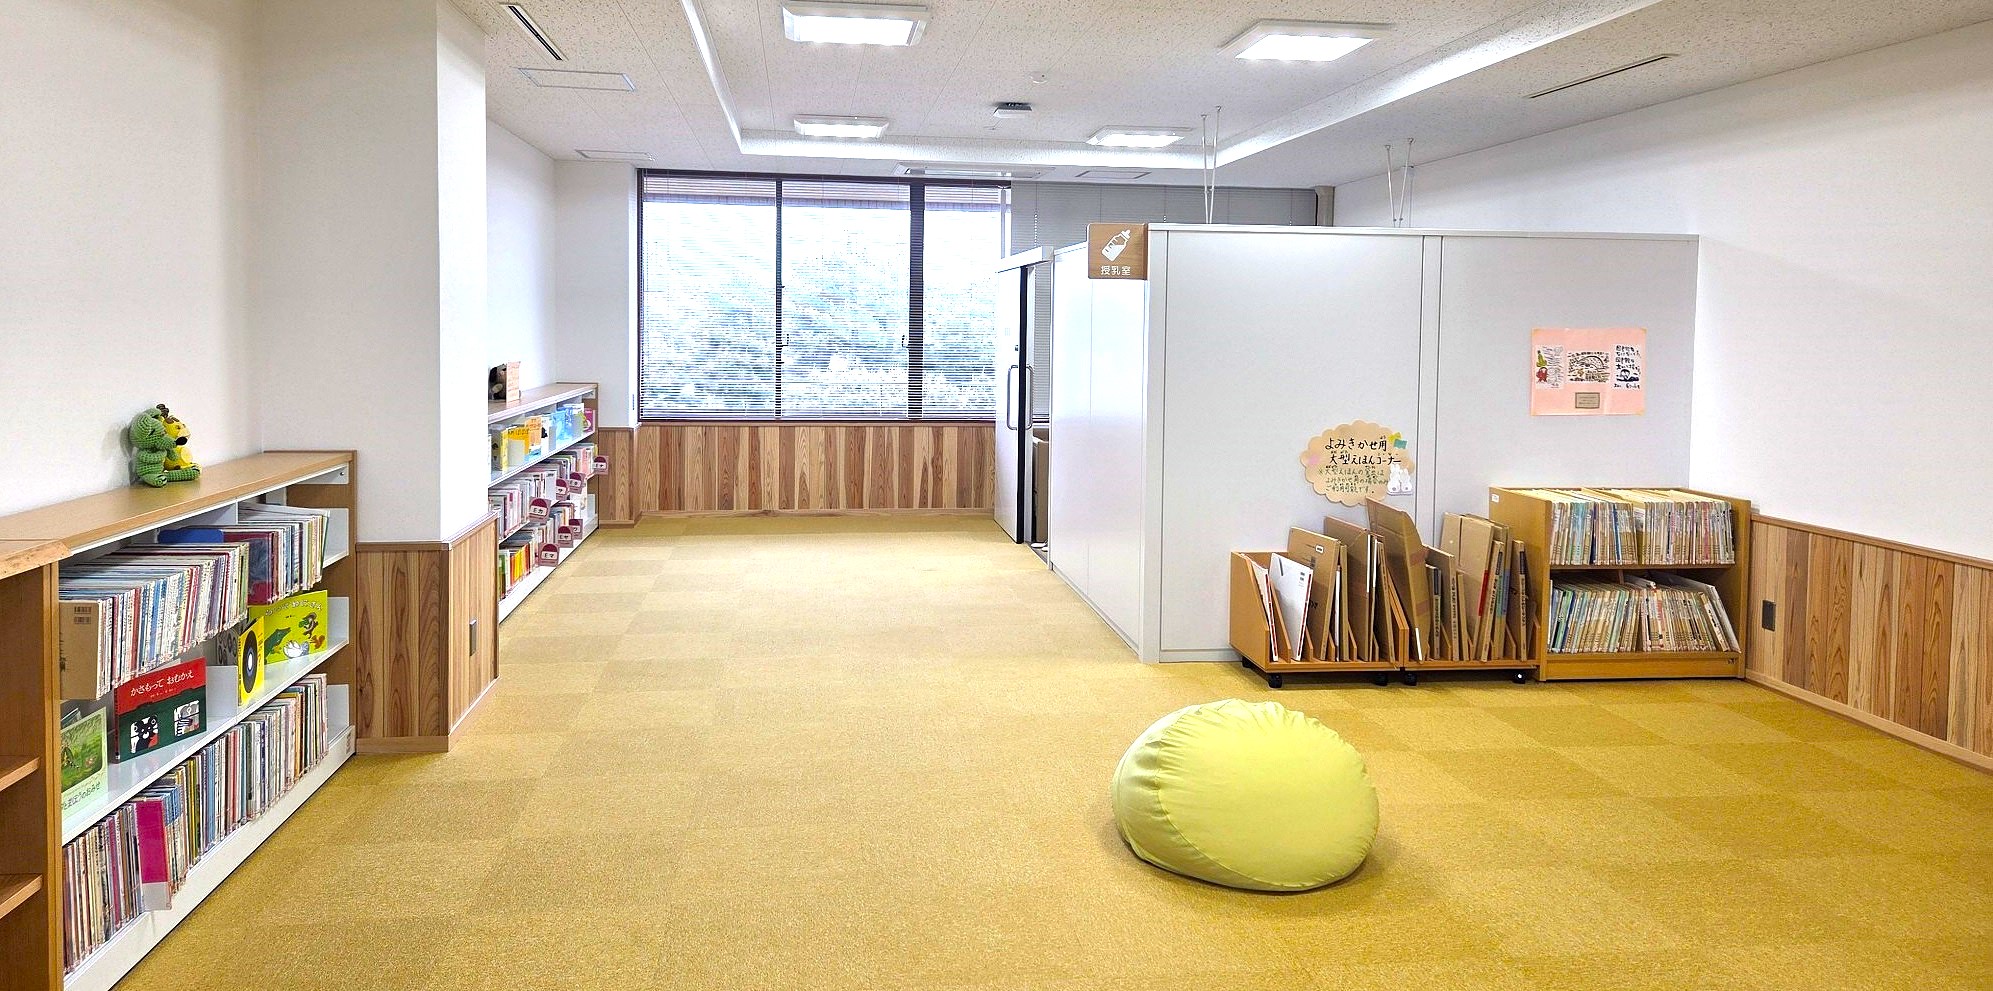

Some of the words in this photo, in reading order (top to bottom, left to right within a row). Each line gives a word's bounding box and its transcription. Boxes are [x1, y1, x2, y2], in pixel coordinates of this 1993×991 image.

[1100, 265, 1131, 276] 授乳室
[1325, 437, 1387, 452] よみきかせ用
[1329, 453, 1402, 465] 大型えほんコーナー
[130, 678, 165, 697] かさもって
[166, 669, 194, 685] おむかえ
